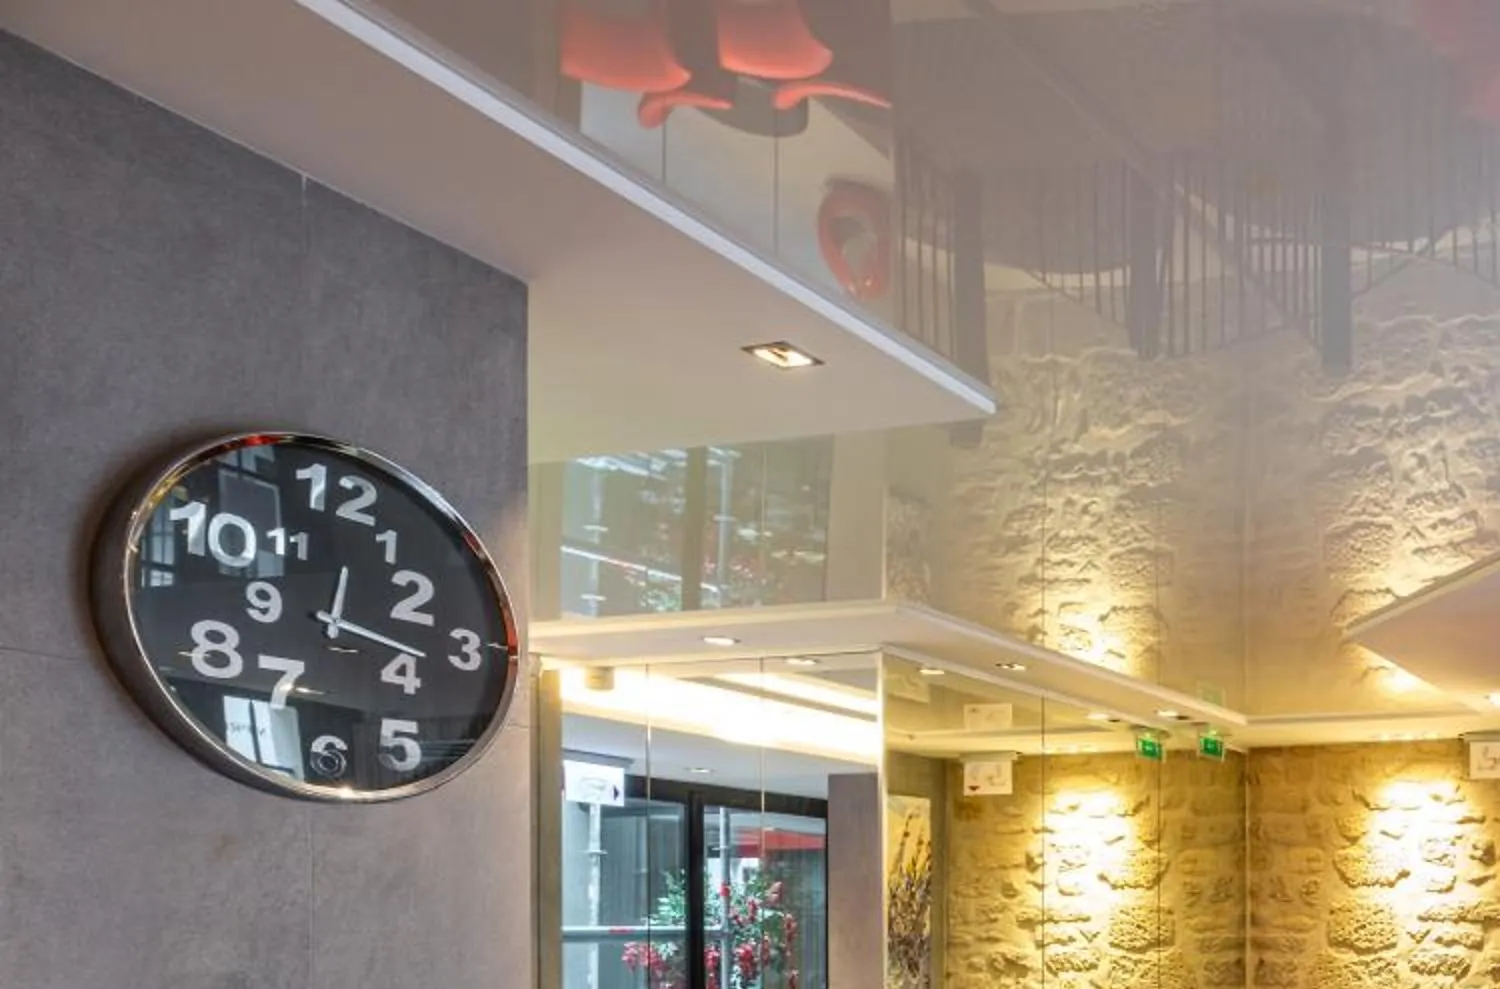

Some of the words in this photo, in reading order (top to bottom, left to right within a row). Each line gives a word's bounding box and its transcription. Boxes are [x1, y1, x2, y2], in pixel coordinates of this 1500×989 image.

[296, 463, 377, 526] 12
[169, 501, 257, 567] 10
[266, 527, 308, 561] 11
[376, 529, 397, 564] 1
[245, 581, 283, 623] 9
[390, 570, 435, 625] 2
[190, 619, 244, 679] 8
[448, 628, 481, 671] 3
[257, 654, 305, 710] 7
[381, 654, 421, 695] 4
[310, 735, 348, 778] 6
[379, 718, 422, 771] 5
